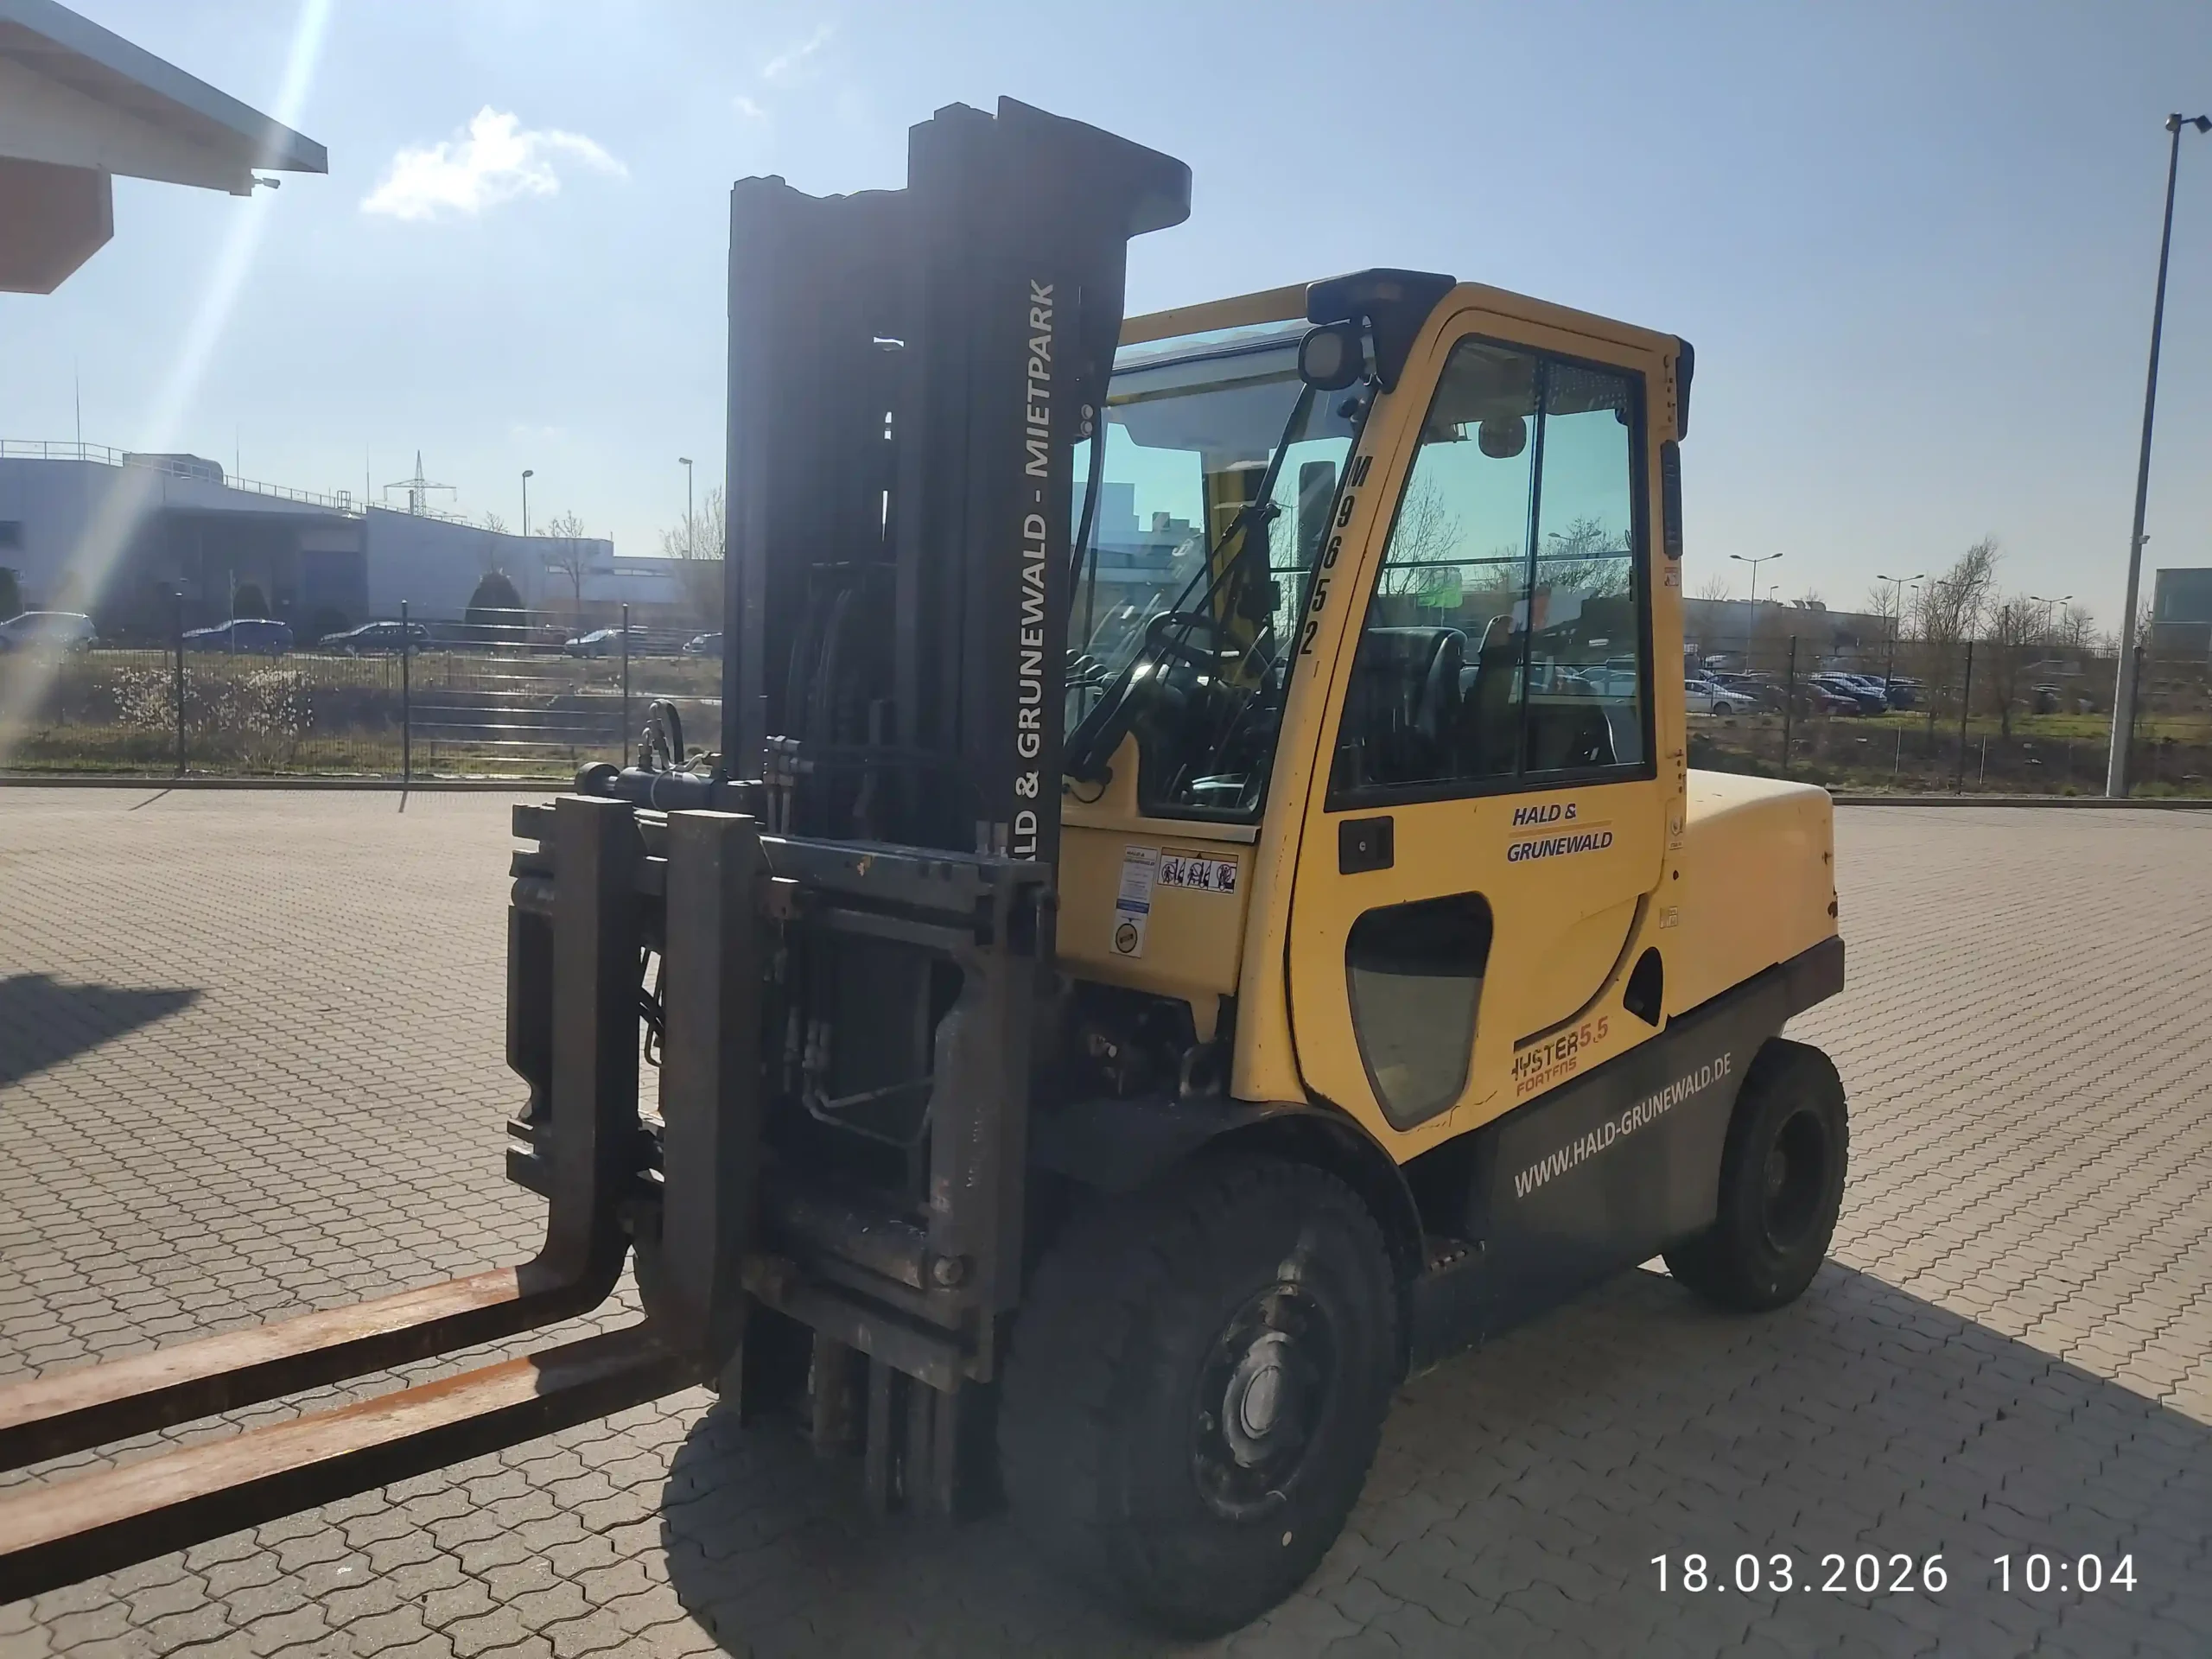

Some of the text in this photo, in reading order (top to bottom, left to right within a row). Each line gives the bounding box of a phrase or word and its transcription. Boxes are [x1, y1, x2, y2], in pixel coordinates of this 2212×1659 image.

[1014, 278, 1054, 861] LD & GRUNEWALD - MIETPARK
[1300, 455, 1374, 655] M9652
[1506, 831, 1613, 862] GRUNEWALD
[1512, 803, 1577, 826] HALD &
[1514, 1052, 1732, 1198] WWW.HALD-GRUNEWALD.DE
